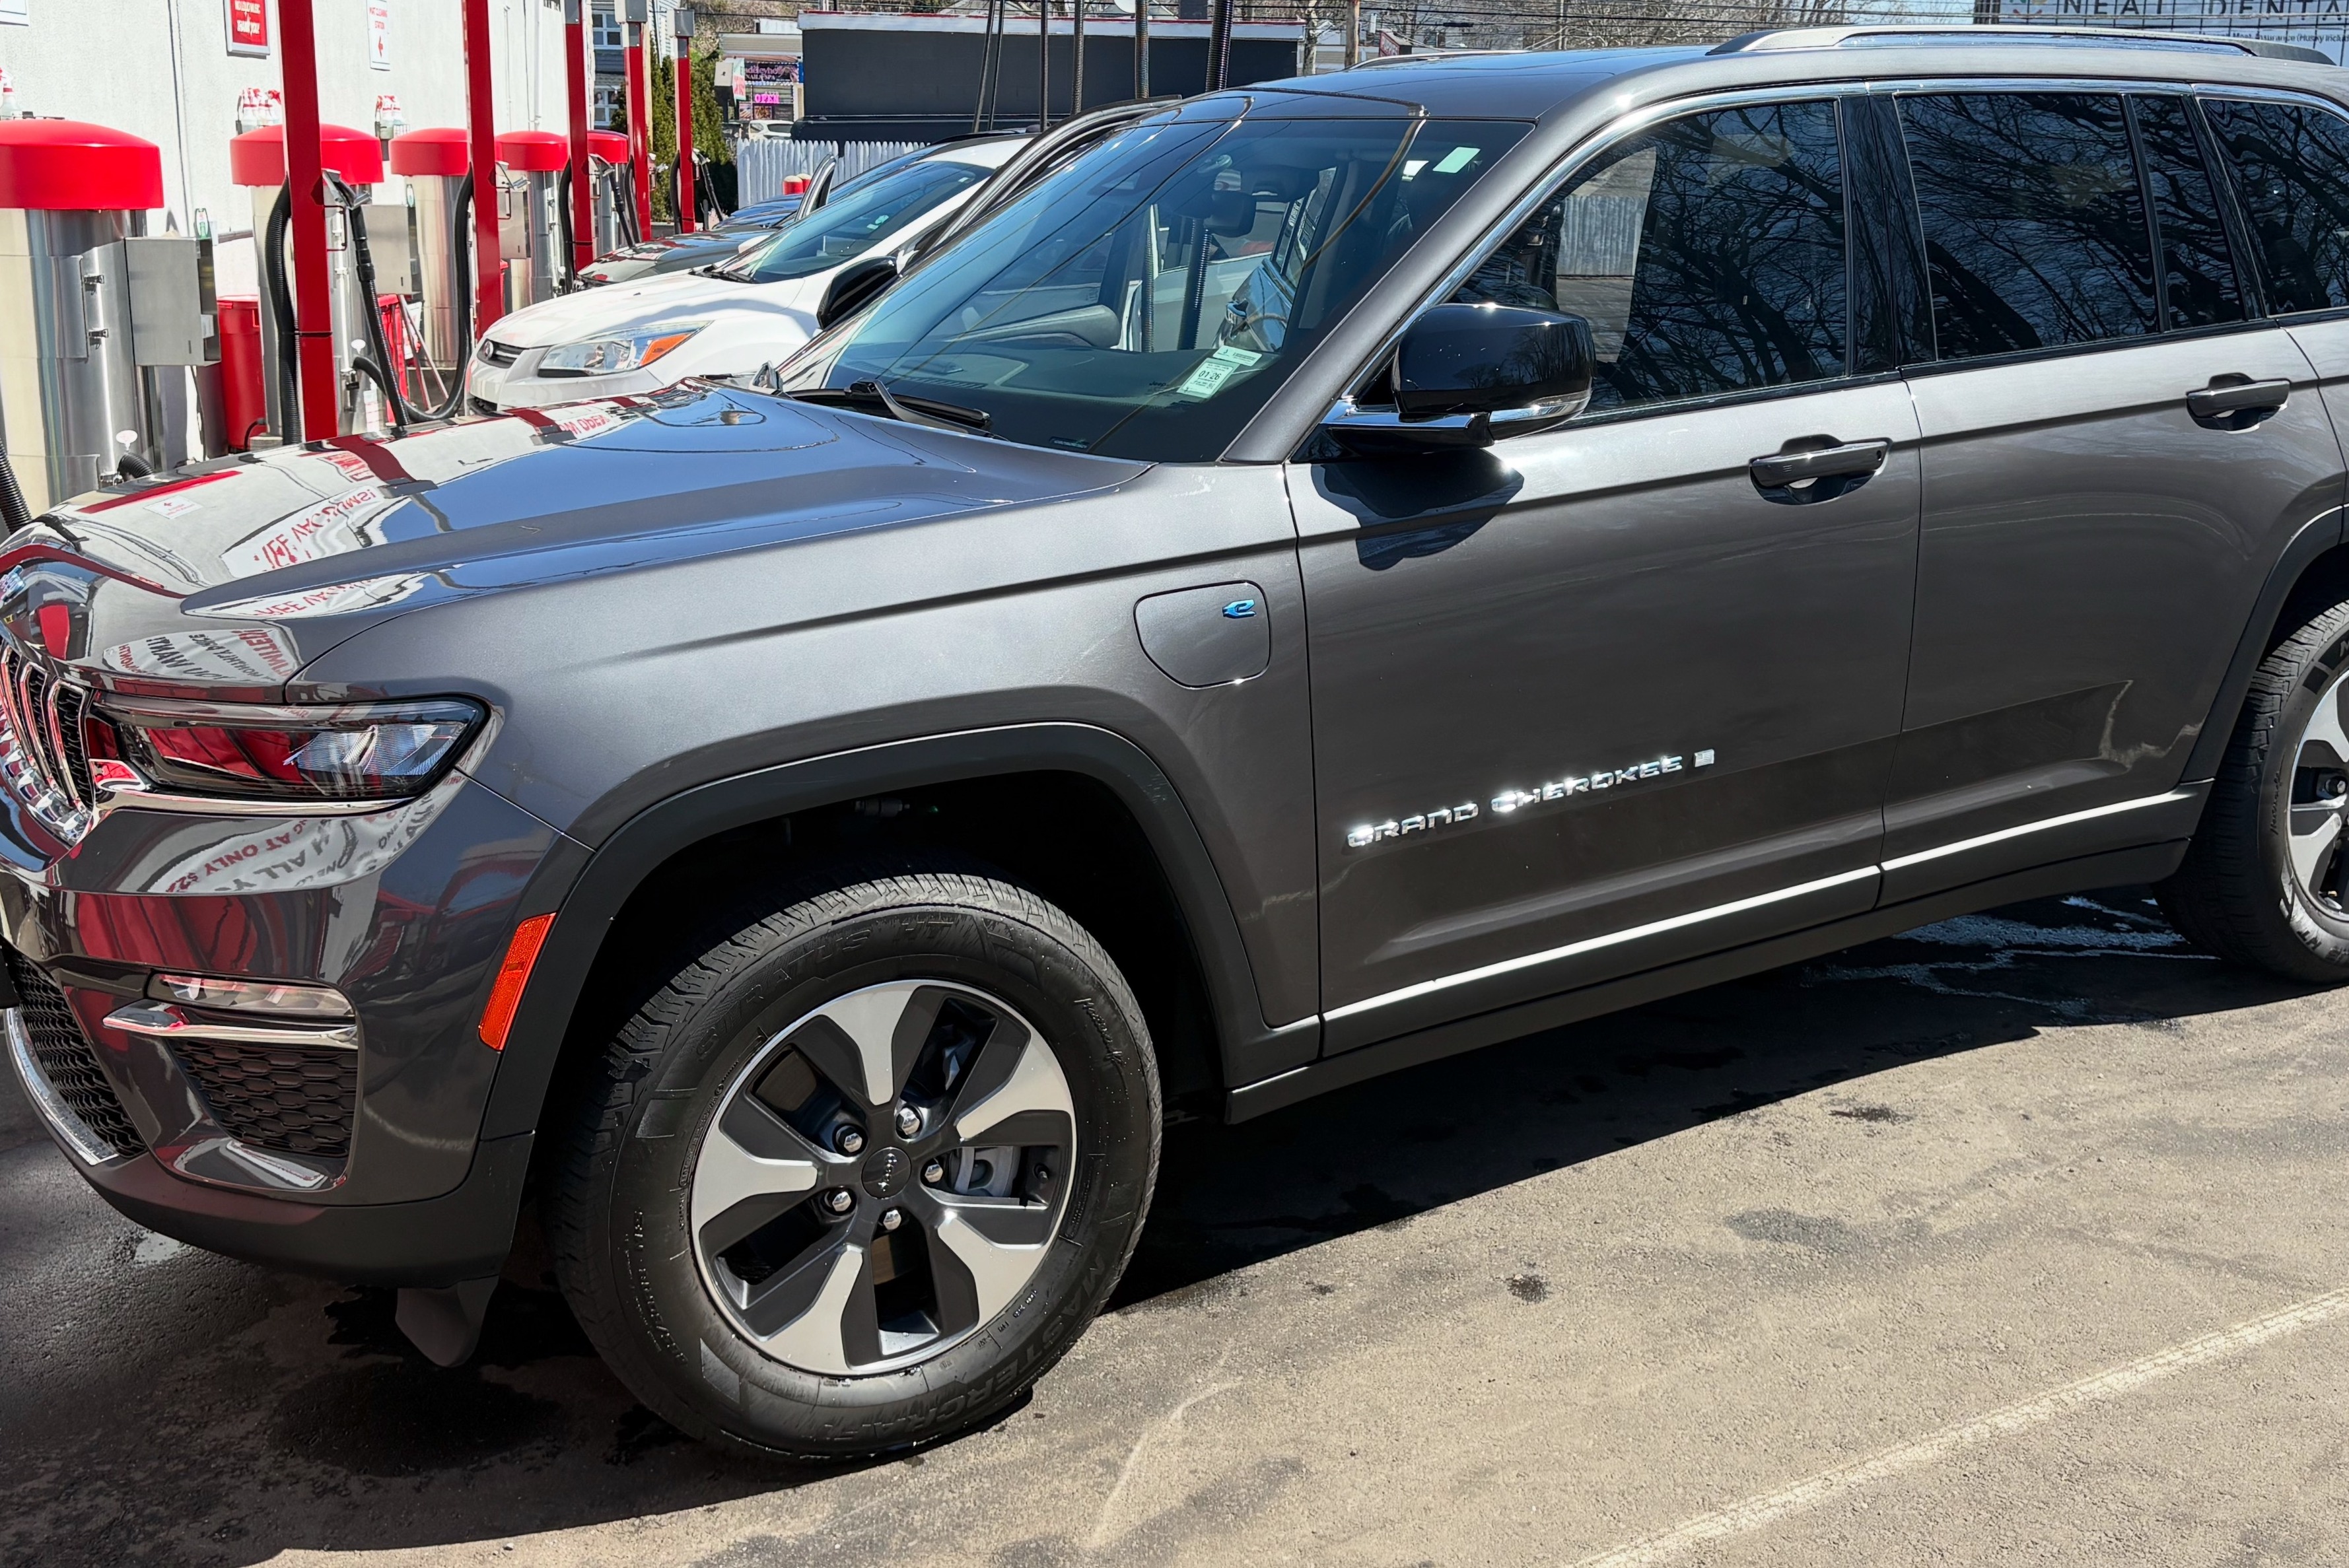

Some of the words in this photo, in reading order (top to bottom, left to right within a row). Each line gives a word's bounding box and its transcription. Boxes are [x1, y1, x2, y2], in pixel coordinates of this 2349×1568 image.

[755, 94, 779, 104] OPEN
[1347, 802, 1479, 848] GRAND
[1490, 755, 1683, 813] CHEROKEE
